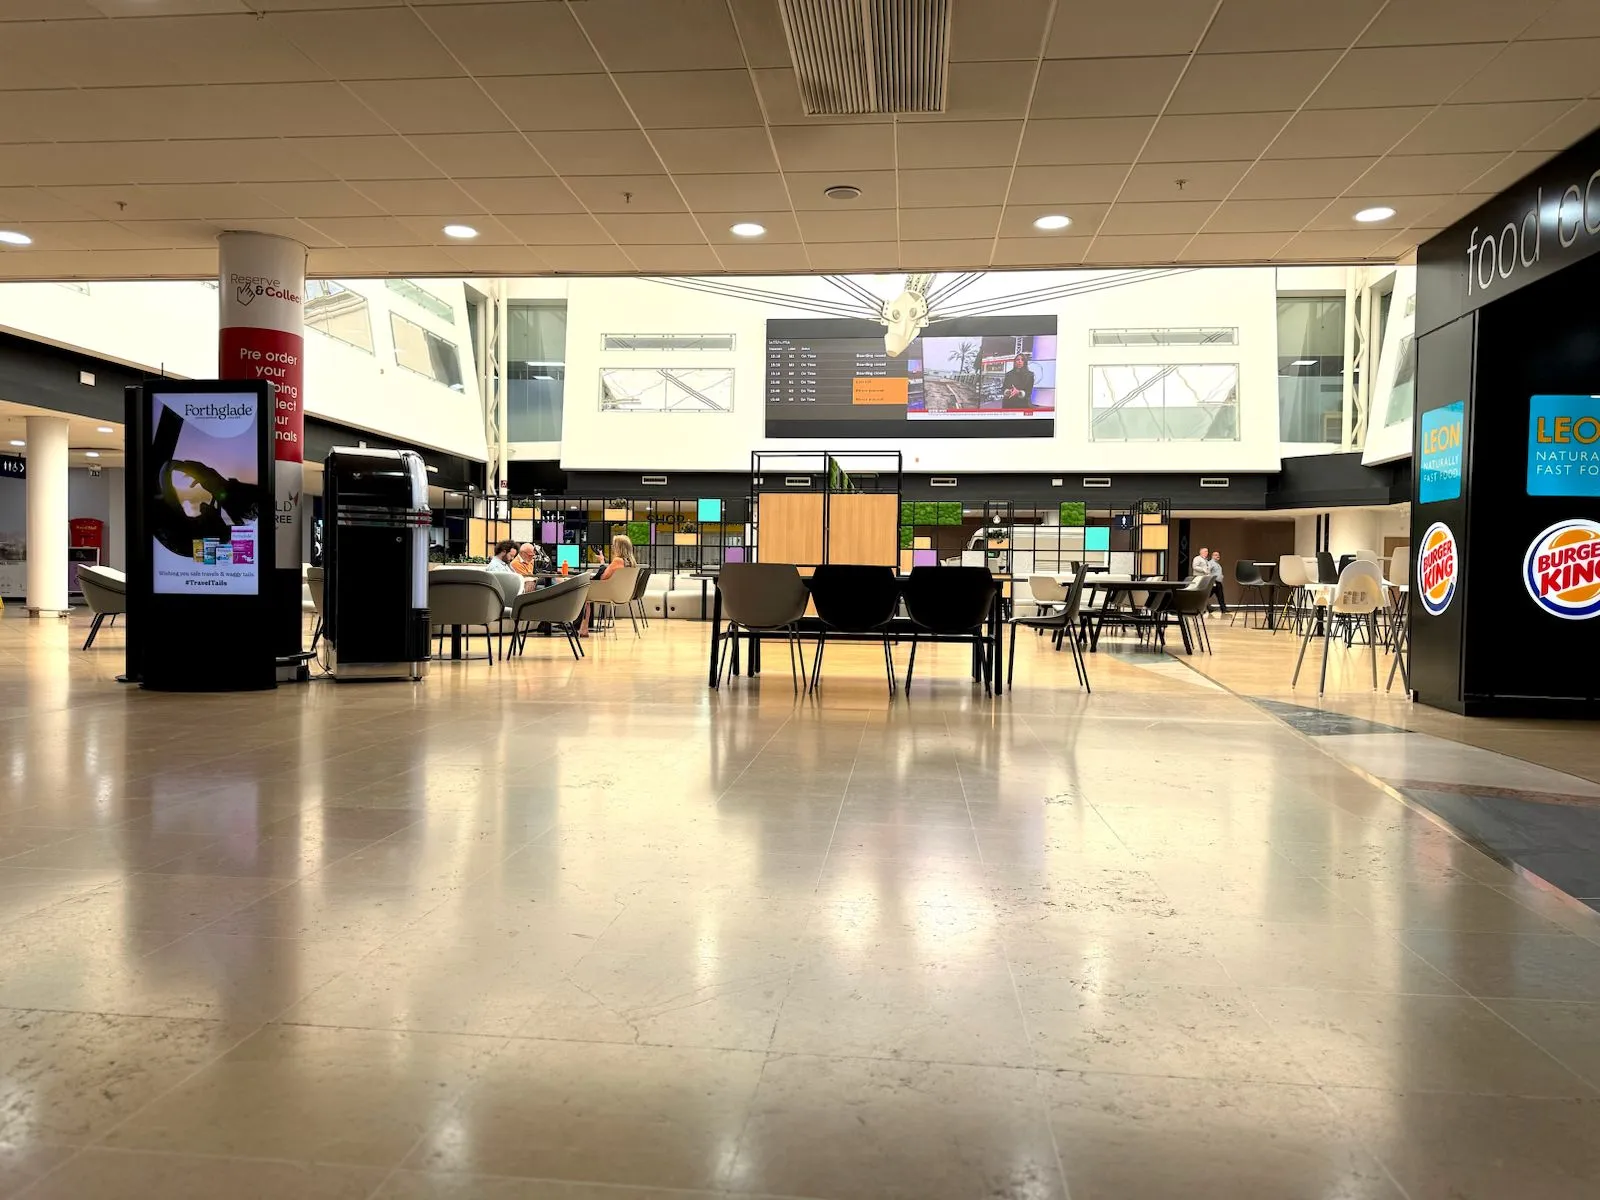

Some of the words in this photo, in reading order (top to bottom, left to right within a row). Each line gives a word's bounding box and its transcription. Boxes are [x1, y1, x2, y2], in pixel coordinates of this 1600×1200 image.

[1466, 187, 1542, 296] food
[230, 273, 280, 288] Reserve
[240, 348, 262, 360] Pre
[265, 352, 298, 366] order
[255, 365, 286, 377] your
[185, 403, 253, 420] Forthglade
[275, 416, 289, 425] ur
[1424, 421, 1461, 455] LEON
[1423, 455, 1460, 470] NATURALLY
[1536, 450, 1600, 461] NATURA
[1423, 471, 1438, 482] FAST
[1440, 467, 1459, 480] FOOD
[1536, 464, 1572, 476] FAST
[1580, 464, 1599, 476] FO
[647, 514, 685, 526] SHOP
[1424, 540, 1452, 572] BURGER
[1538, 541, 1600, 573] BURGE
[1424, 555, 1453, 594] KING
